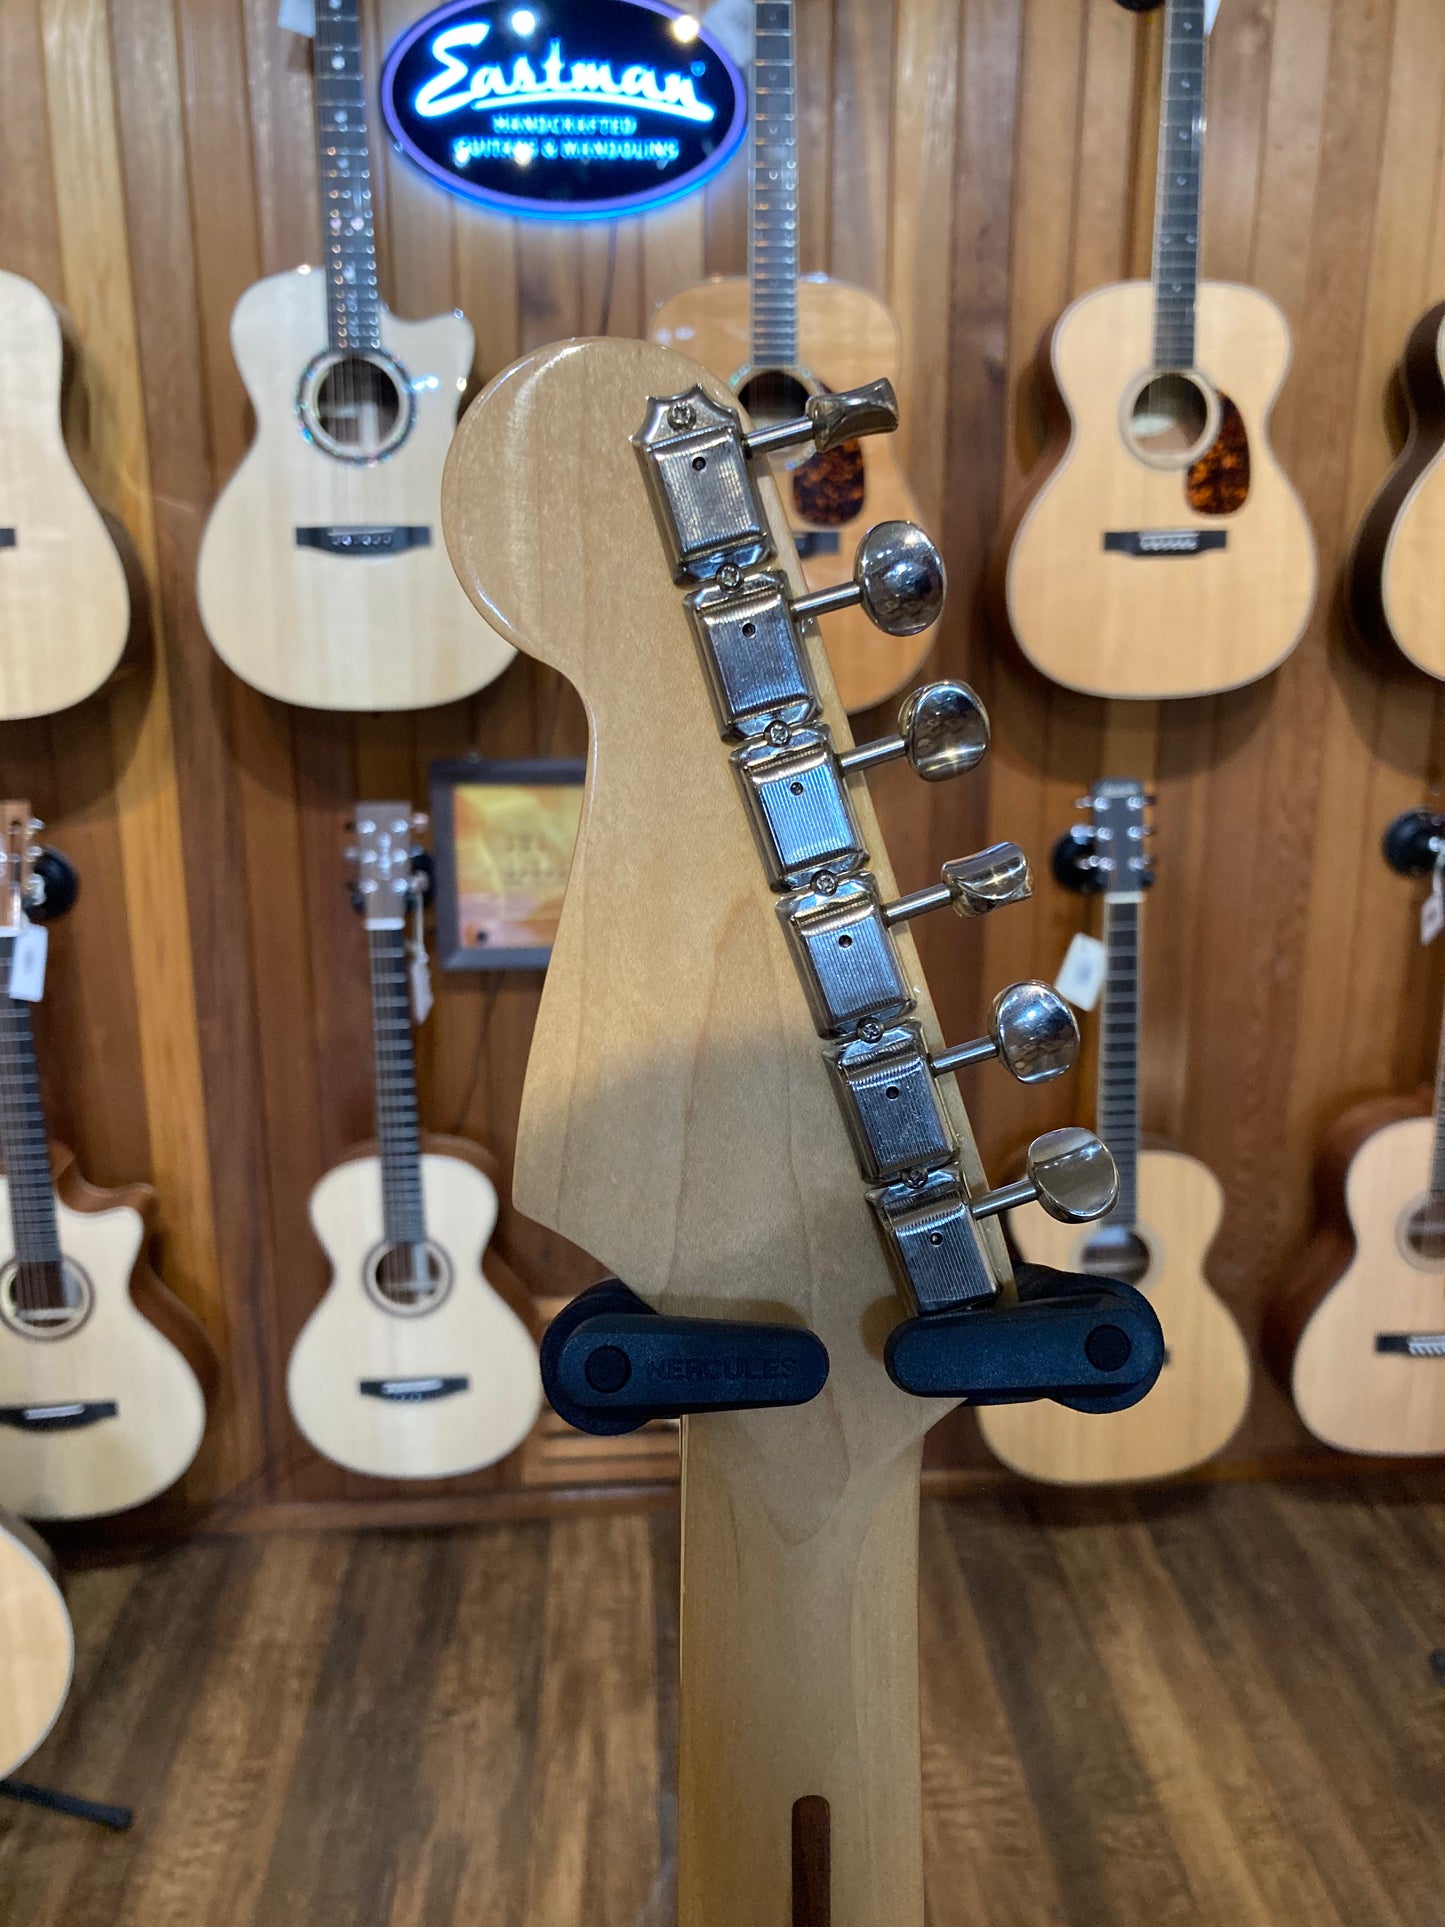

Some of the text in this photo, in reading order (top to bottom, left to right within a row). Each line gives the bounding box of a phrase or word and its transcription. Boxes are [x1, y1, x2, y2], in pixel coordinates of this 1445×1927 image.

[415, 23, 714, 121] Eastman
[492, 115, 637, 135] HANDCRAFTED
[541, 139, 557, 158] &
[646, 1356, 797, 1380] HERCULES
